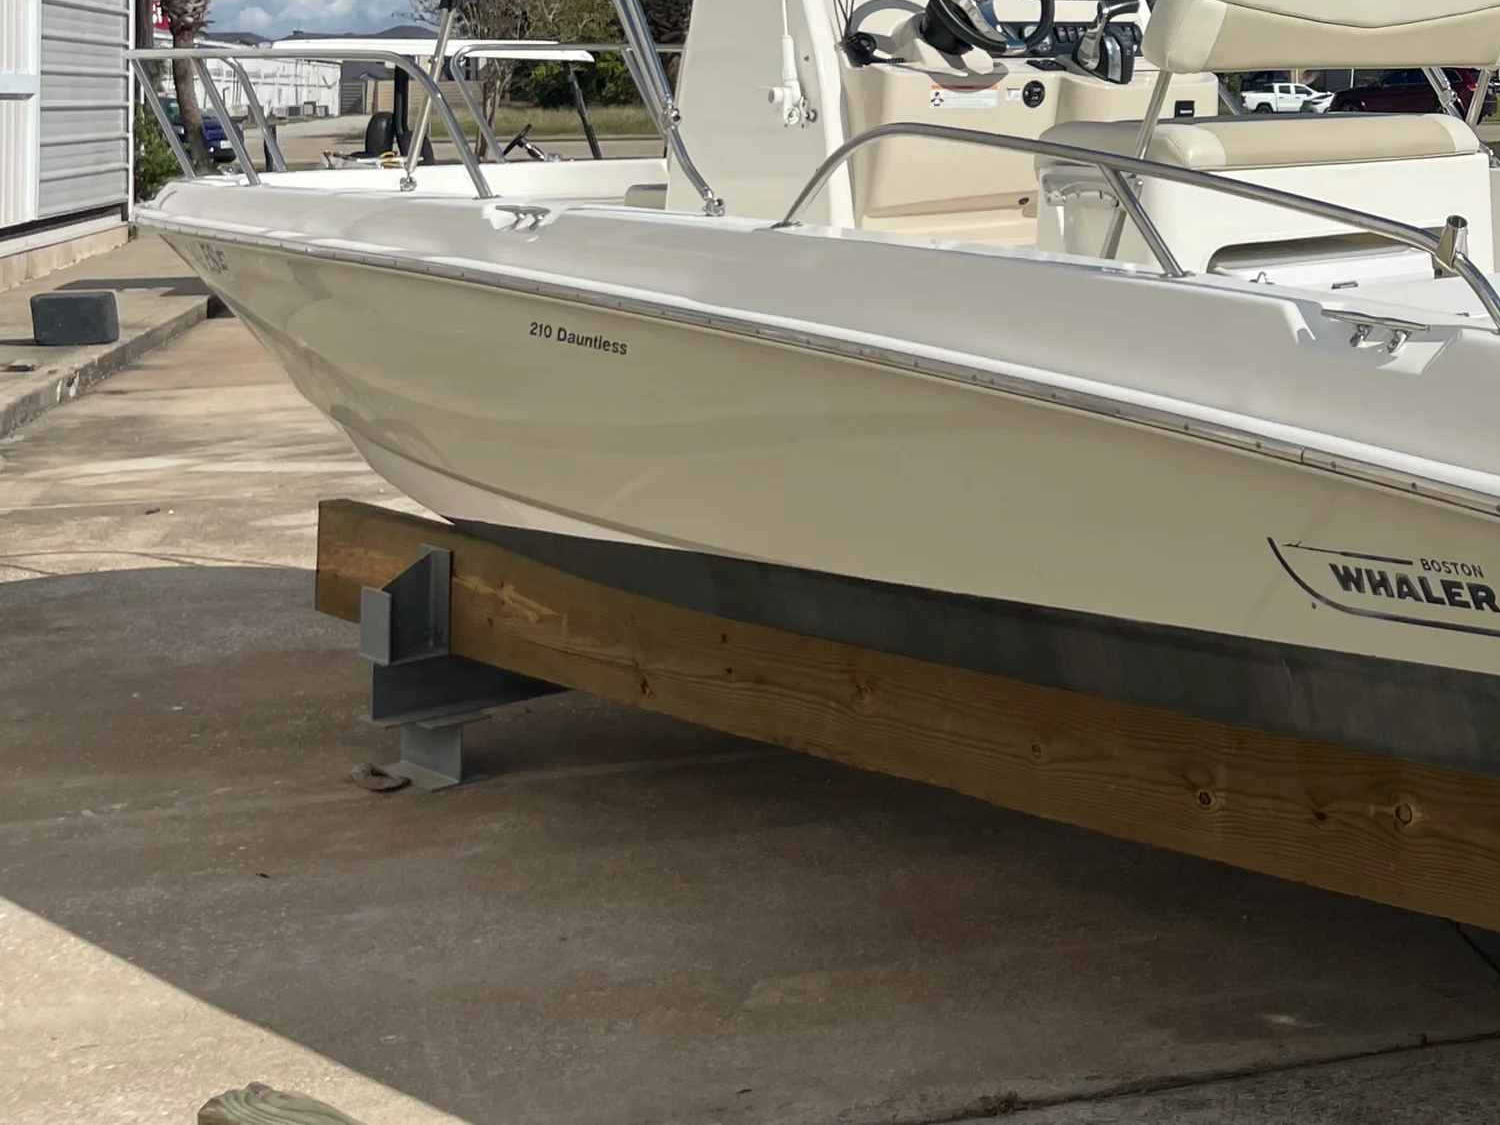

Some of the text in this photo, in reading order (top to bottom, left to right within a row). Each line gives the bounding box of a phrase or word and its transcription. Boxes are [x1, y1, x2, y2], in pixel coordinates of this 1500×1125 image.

[529, 321, 628, 355] 210 Dauntless
[1419, 557, 1485, 579] BOSTON
